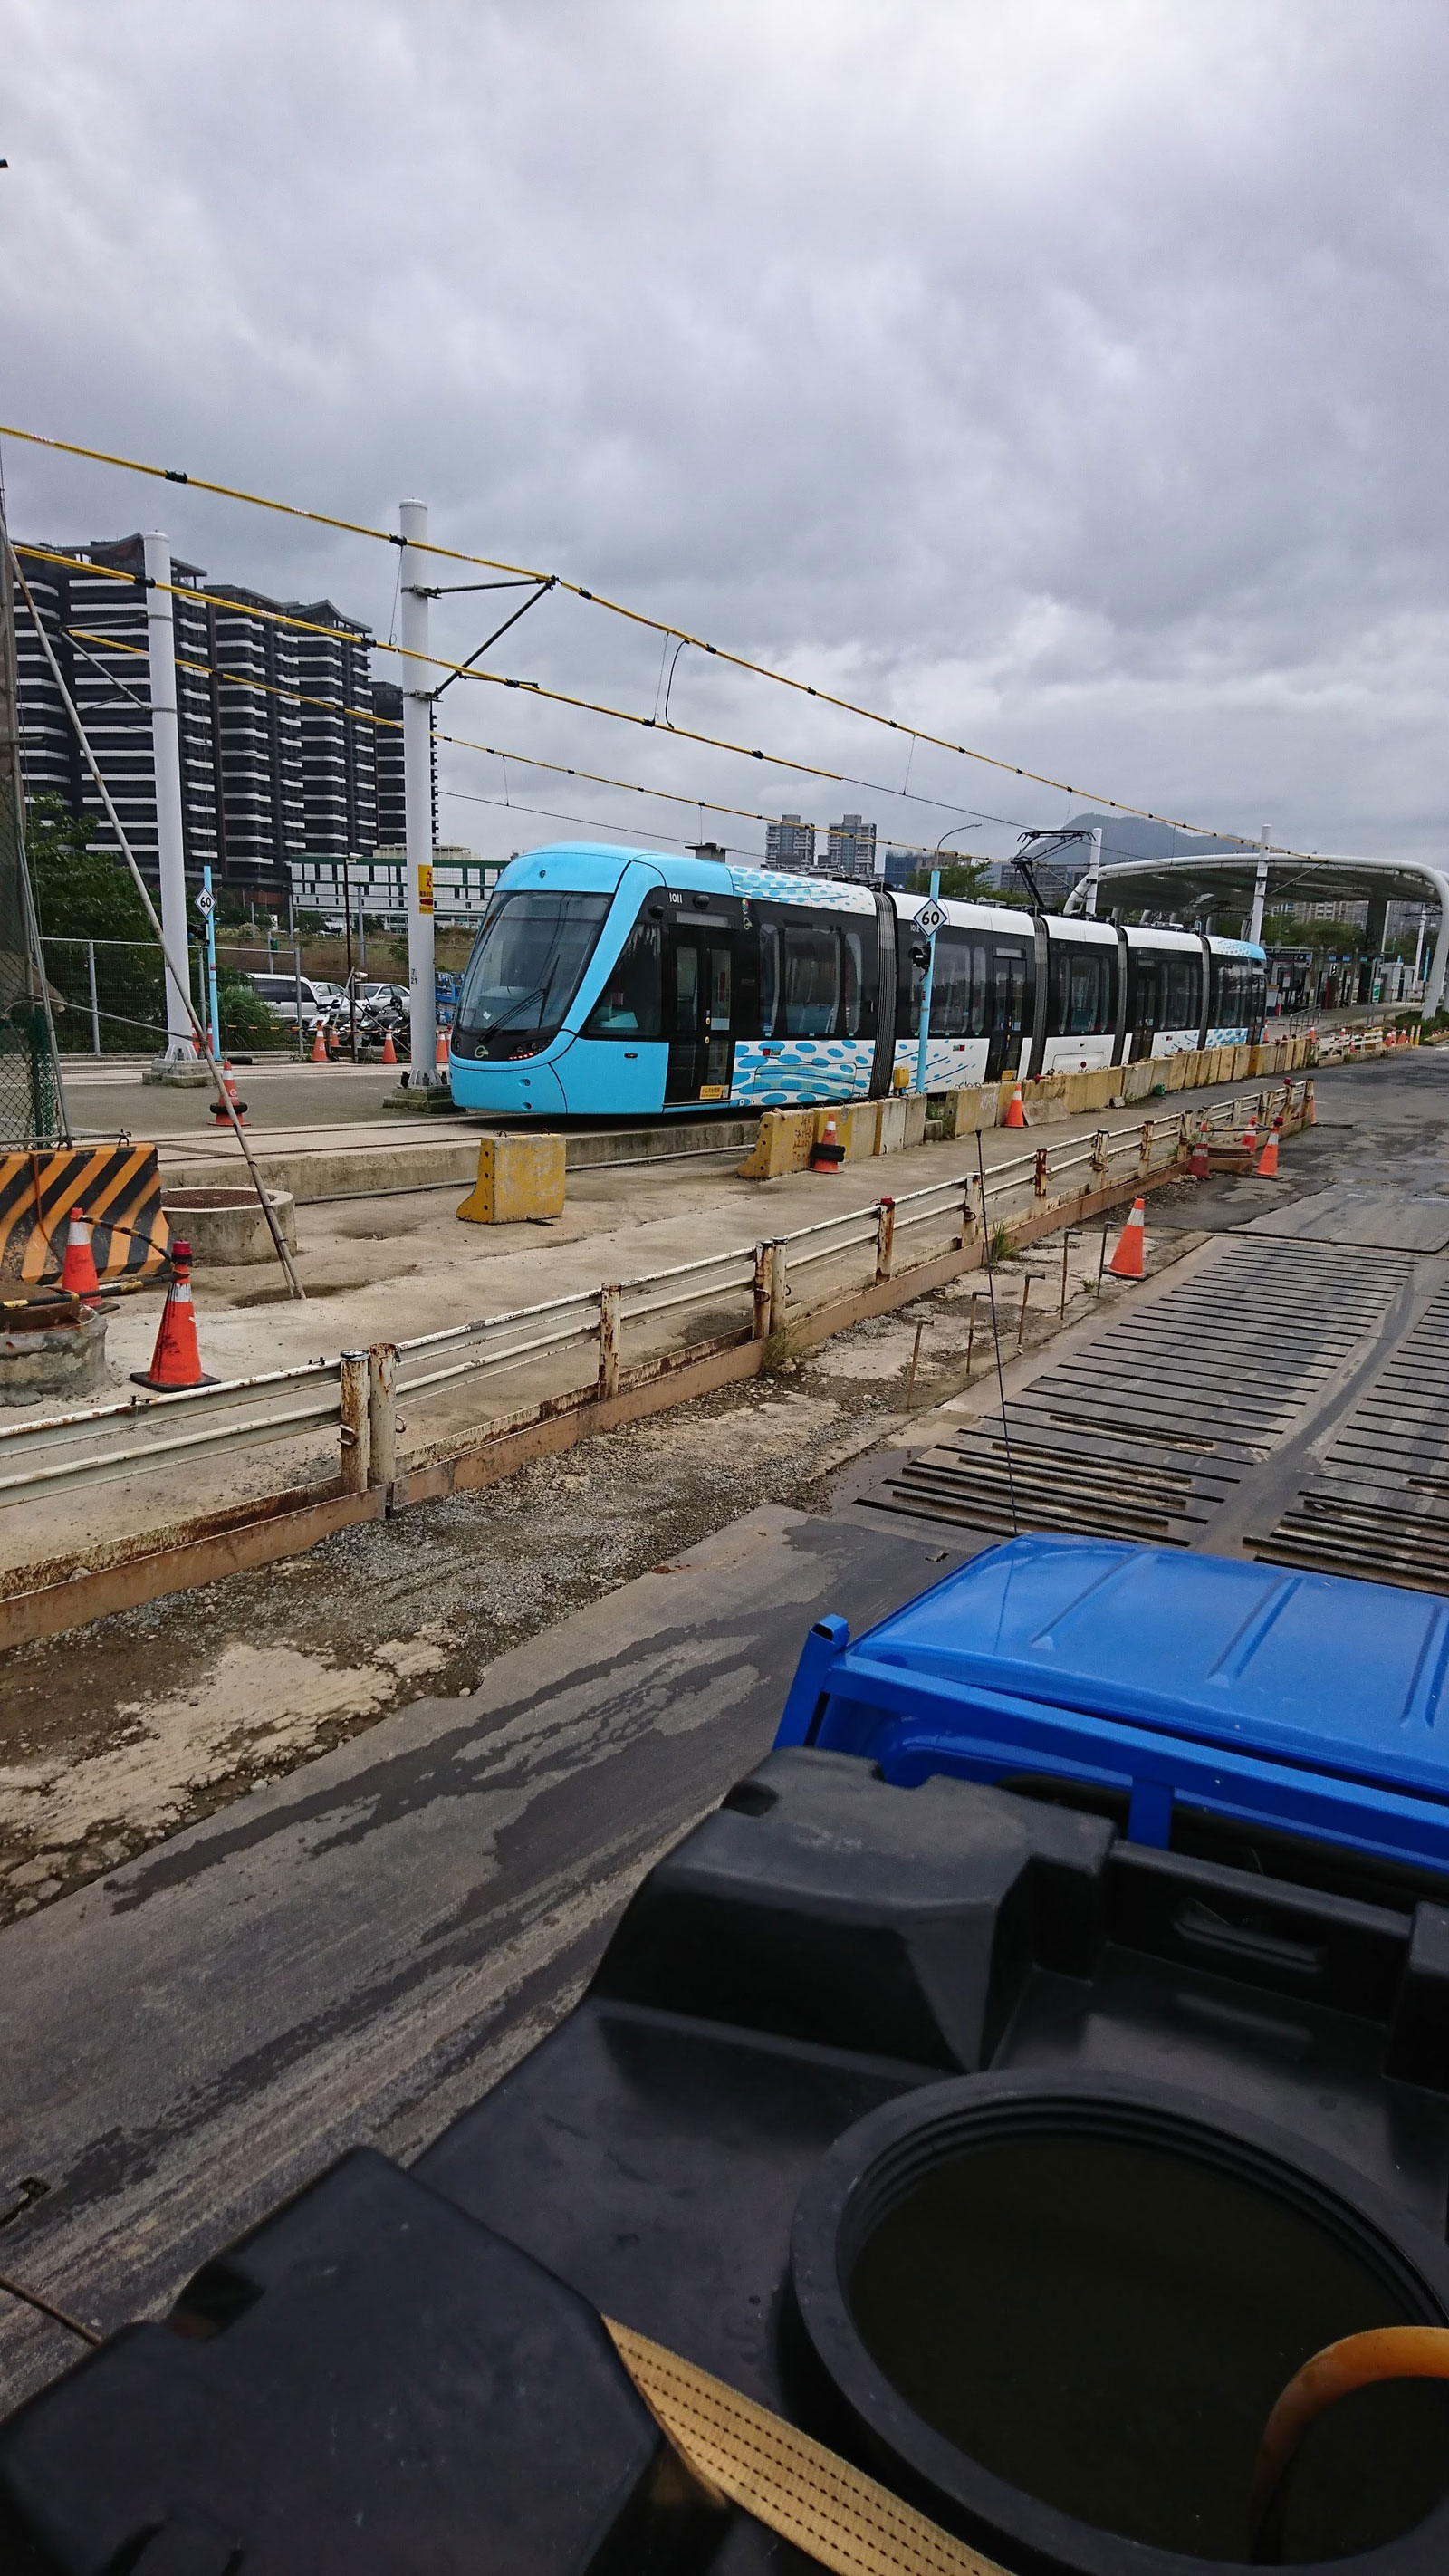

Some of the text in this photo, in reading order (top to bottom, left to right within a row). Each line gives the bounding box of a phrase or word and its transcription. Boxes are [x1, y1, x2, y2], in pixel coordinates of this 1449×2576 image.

[200, 896, 212, 908] 60
[669, 892, 683, 904] 1011
[922, 910, 940, 925] 60
